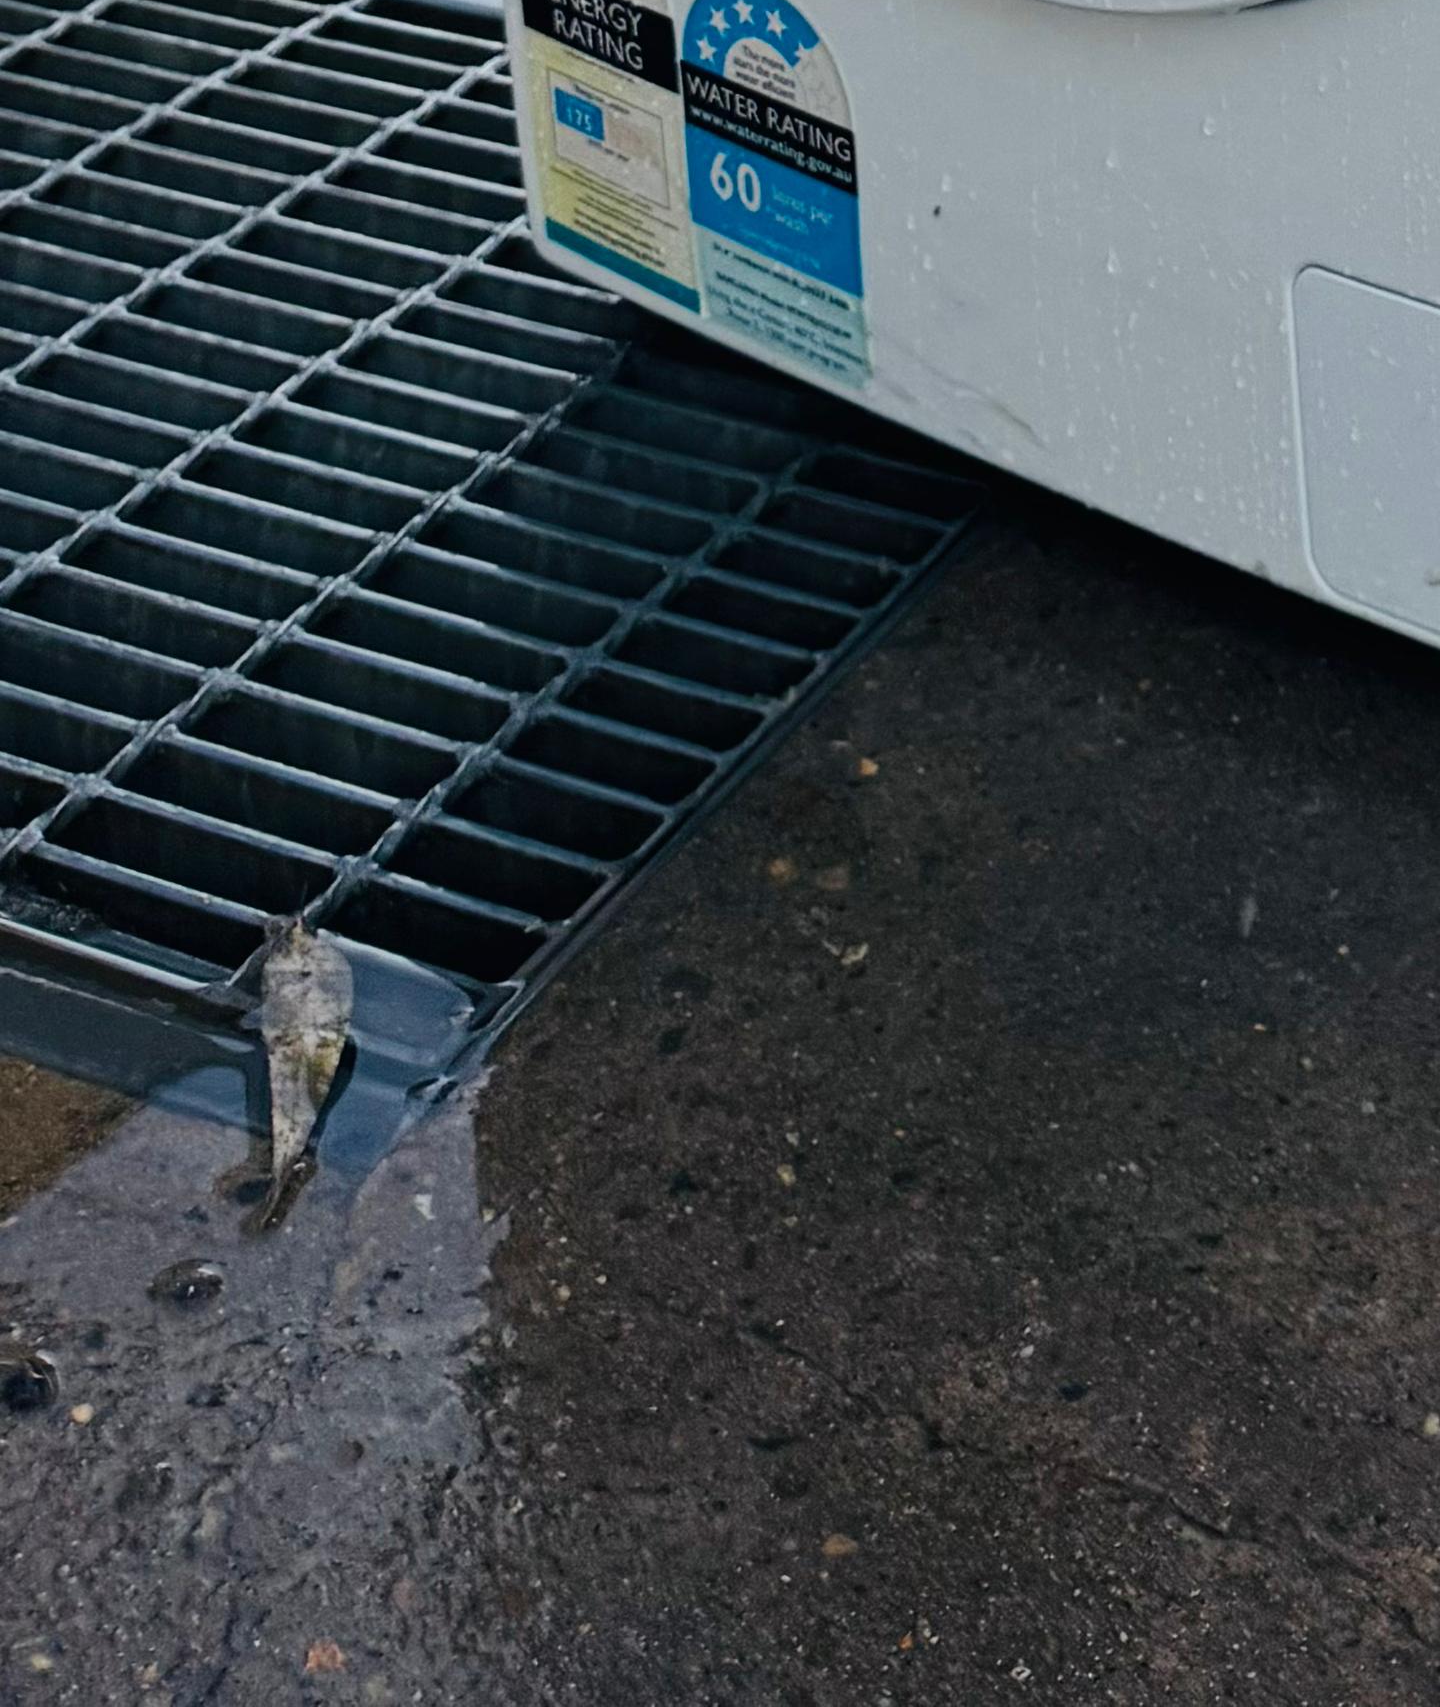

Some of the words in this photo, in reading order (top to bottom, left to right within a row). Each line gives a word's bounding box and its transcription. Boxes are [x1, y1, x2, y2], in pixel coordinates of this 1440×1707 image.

[553, 8, 645, 71] RATING
[685, 71, 762, 125] WATER
[766, 105, 852, 163] RATING
[688, 103, 853, 184] www.waterrating.gov.au
[709, 151, 761, 213] 60
